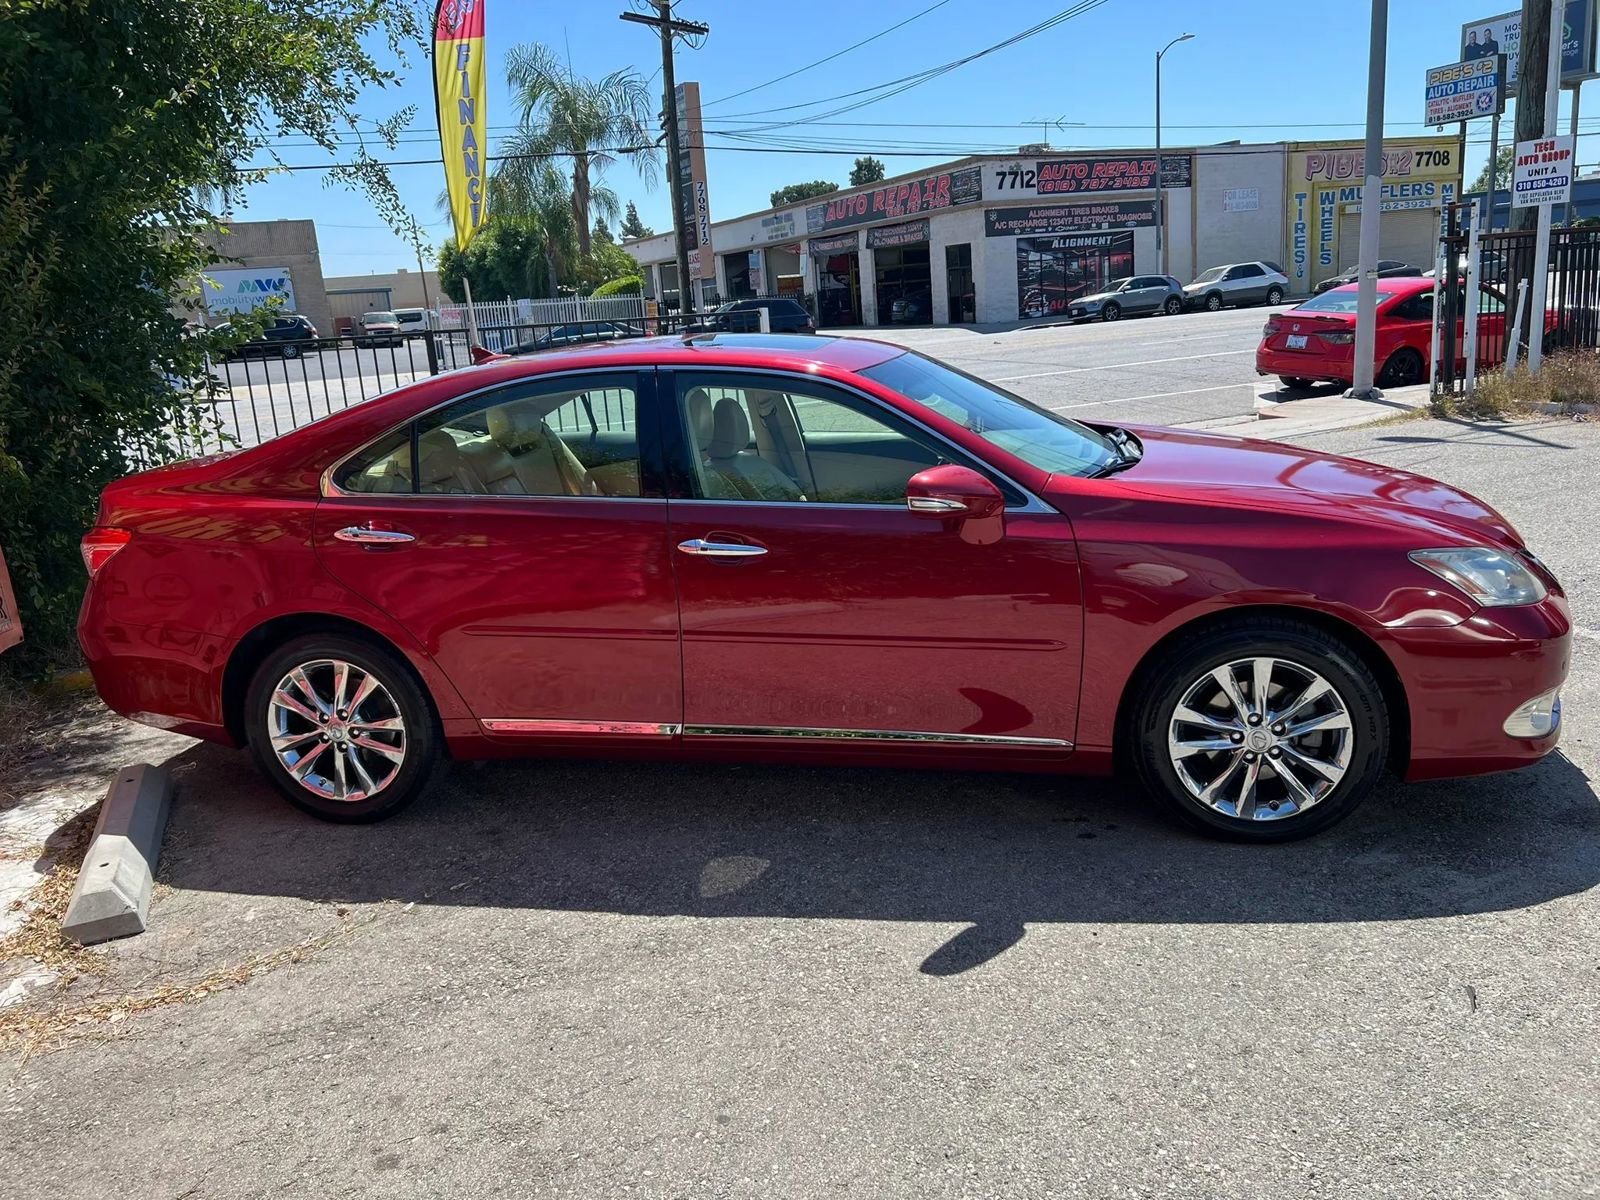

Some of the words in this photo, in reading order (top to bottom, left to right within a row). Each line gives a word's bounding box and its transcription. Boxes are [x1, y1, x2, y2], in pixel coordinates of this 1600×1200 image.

[1428, 83, 1454, 98] AUTO
[1457, 75, 1494, 92] REPAIR
[1428, 109, 1474, 123] 818-582-3924
[456, 43, 481, 228] FINANCE
[1534, 141, 1555, 153] TECH
[1416, 150, 1450, 168] 7708
[1518, 154, 1539, 166] AUTO
[1541, 149, 1570, 163] GROUP
[996, 169, 1036, 190] 7712
[1039, 163, 1088, 181] AUTO
[1528, 167, 1549, 177] UNIT
[1551, 166, 1557, 174] A
[1038, 180, 1076, 192] (818)
[1517, 181, 1531, 190] 310
[697, 181, 706, 212] 7708
[825, 193, 868, 222] AUTO
[873, 175, 951, 211] REPAIR
[1029, 207, 1069, 218] ALIGNMENT
[1070, 206, 1090, 216] TIRES
[1091, 204, 1119, 215] BRAKES
[994, 220, 1007, 230] A/C
[1008, 218, 1048, 229] RECHARGE
[1074, 214, 1115, 225] ELECTRICAL
[1116, 212, 1152, 222] DIAGNOSIS
[1294, 193, 1307, 264] TIRES
[1320, 191, 1335, 265] WHEELS
[700, 215, 709, 246] 7712
[1052, 234, 1113, 249] ALIGNMENT
